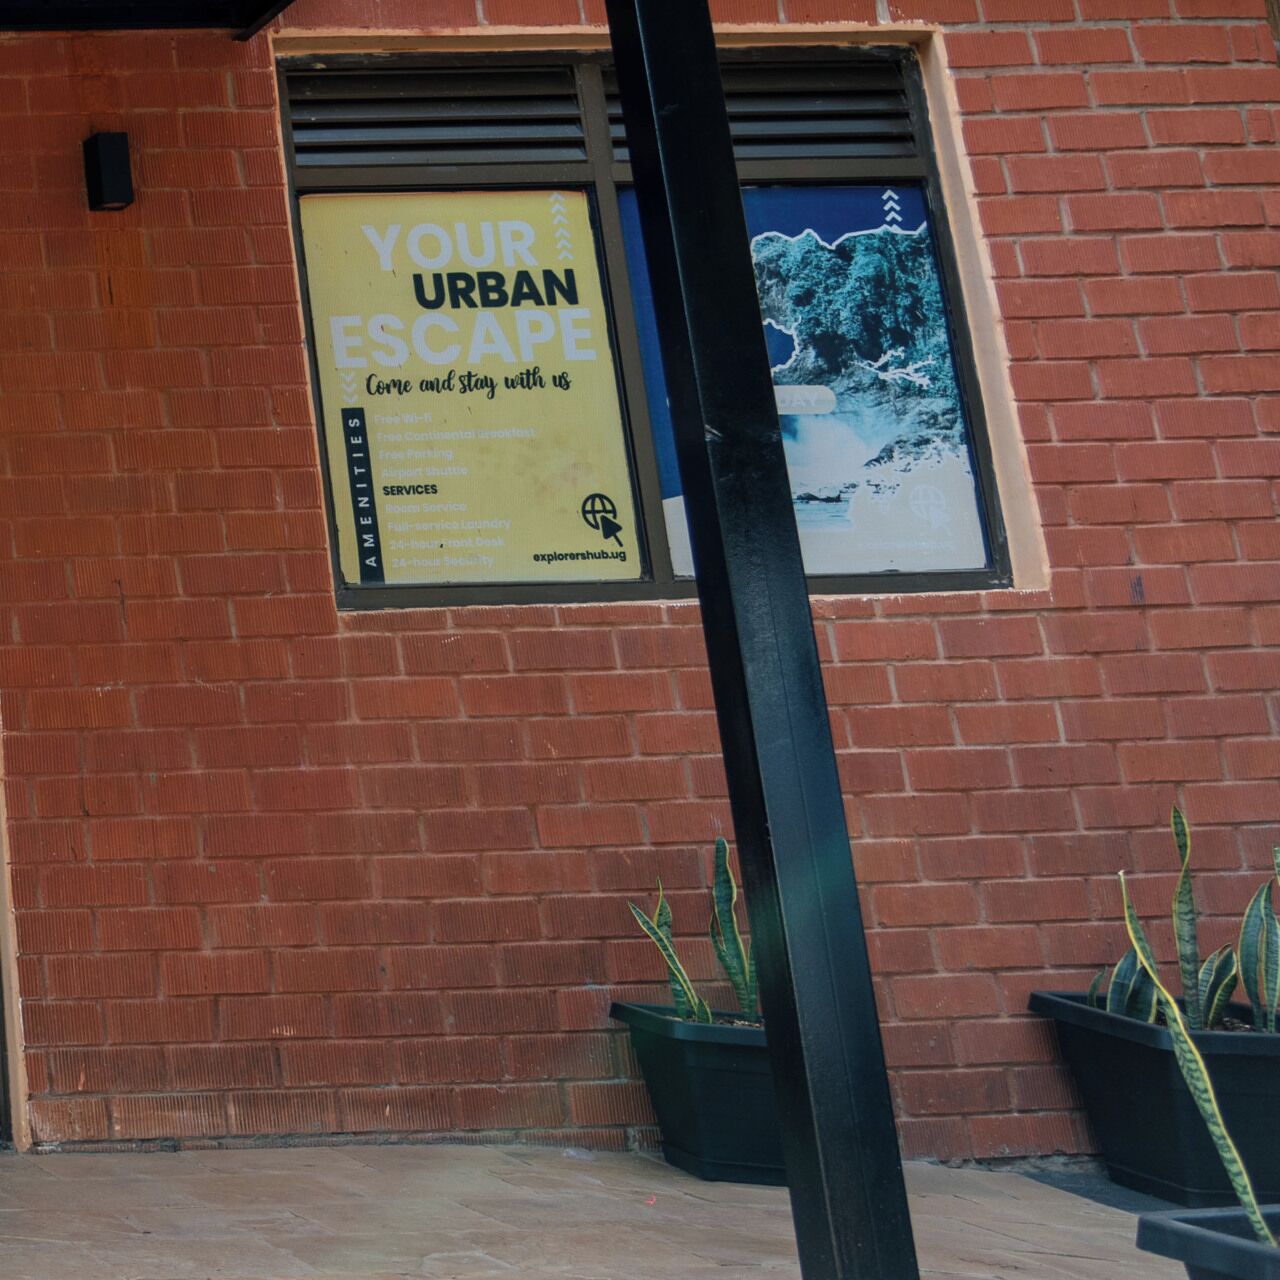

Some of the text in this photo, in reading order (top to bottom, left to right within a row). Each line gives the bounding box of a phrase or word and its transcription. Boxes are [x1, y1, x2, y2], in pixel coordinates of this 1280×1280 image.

[361, 220, 538, 271] YOUR
[413, 268, 579, 310] URBAN
[329, 307, 597, 369] ESCAPE
[366, 366, 572, 400] Come and stay with us
[348, 417, 377, 568] AMENITIES
[382, 484, 438, 496] SERVICES
[533, 549, 627, 563] explorershub.ug
